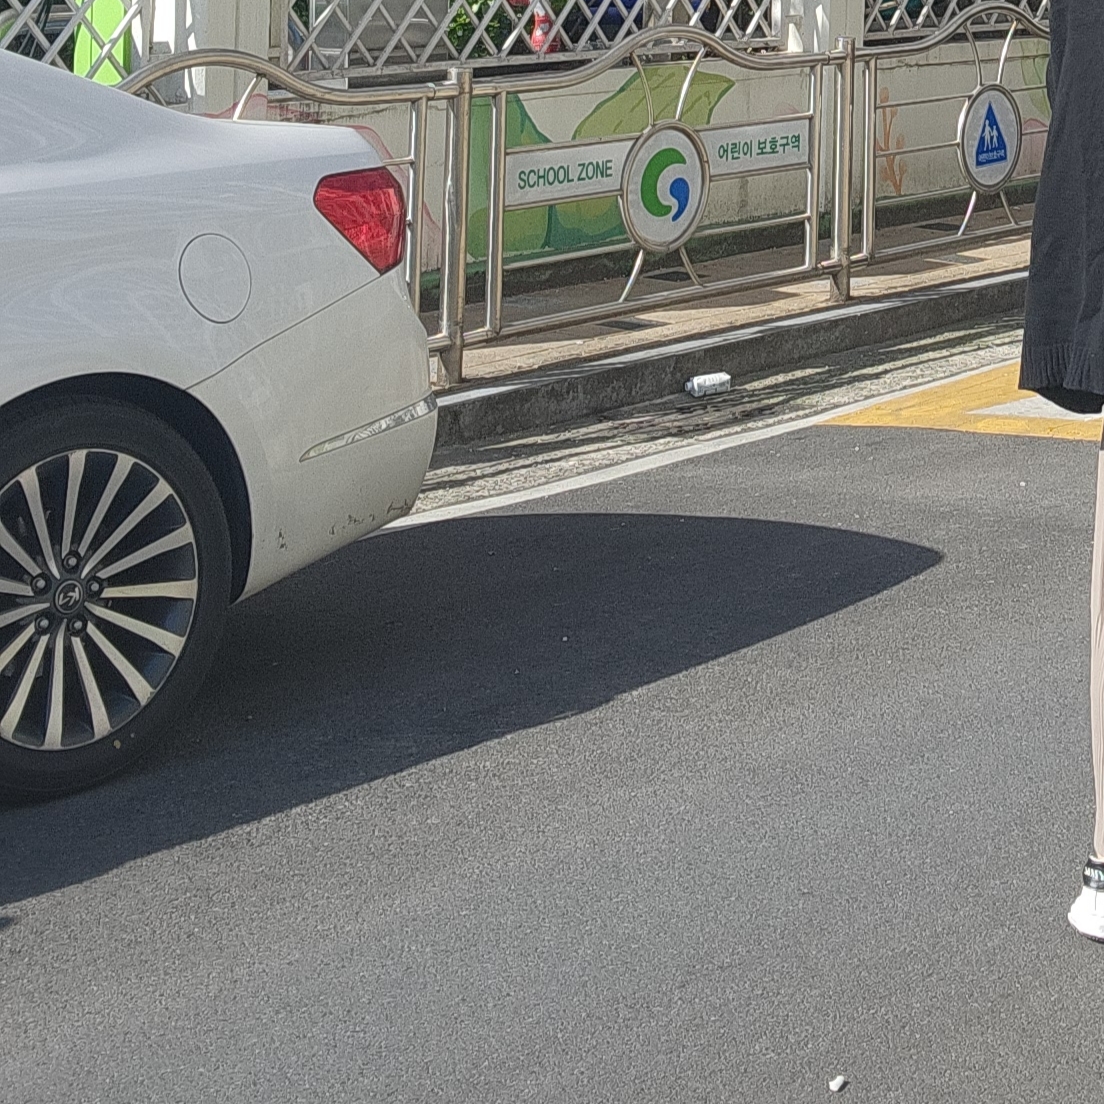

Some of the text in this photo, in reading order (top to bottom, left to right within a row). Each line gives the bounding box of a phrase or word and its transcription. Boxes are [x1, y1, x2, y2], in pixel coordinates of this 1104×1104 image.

[717, 133, 801, 162] 어린이 보호구역
[517, 159, 613, 190] SCHOOL ZONE
